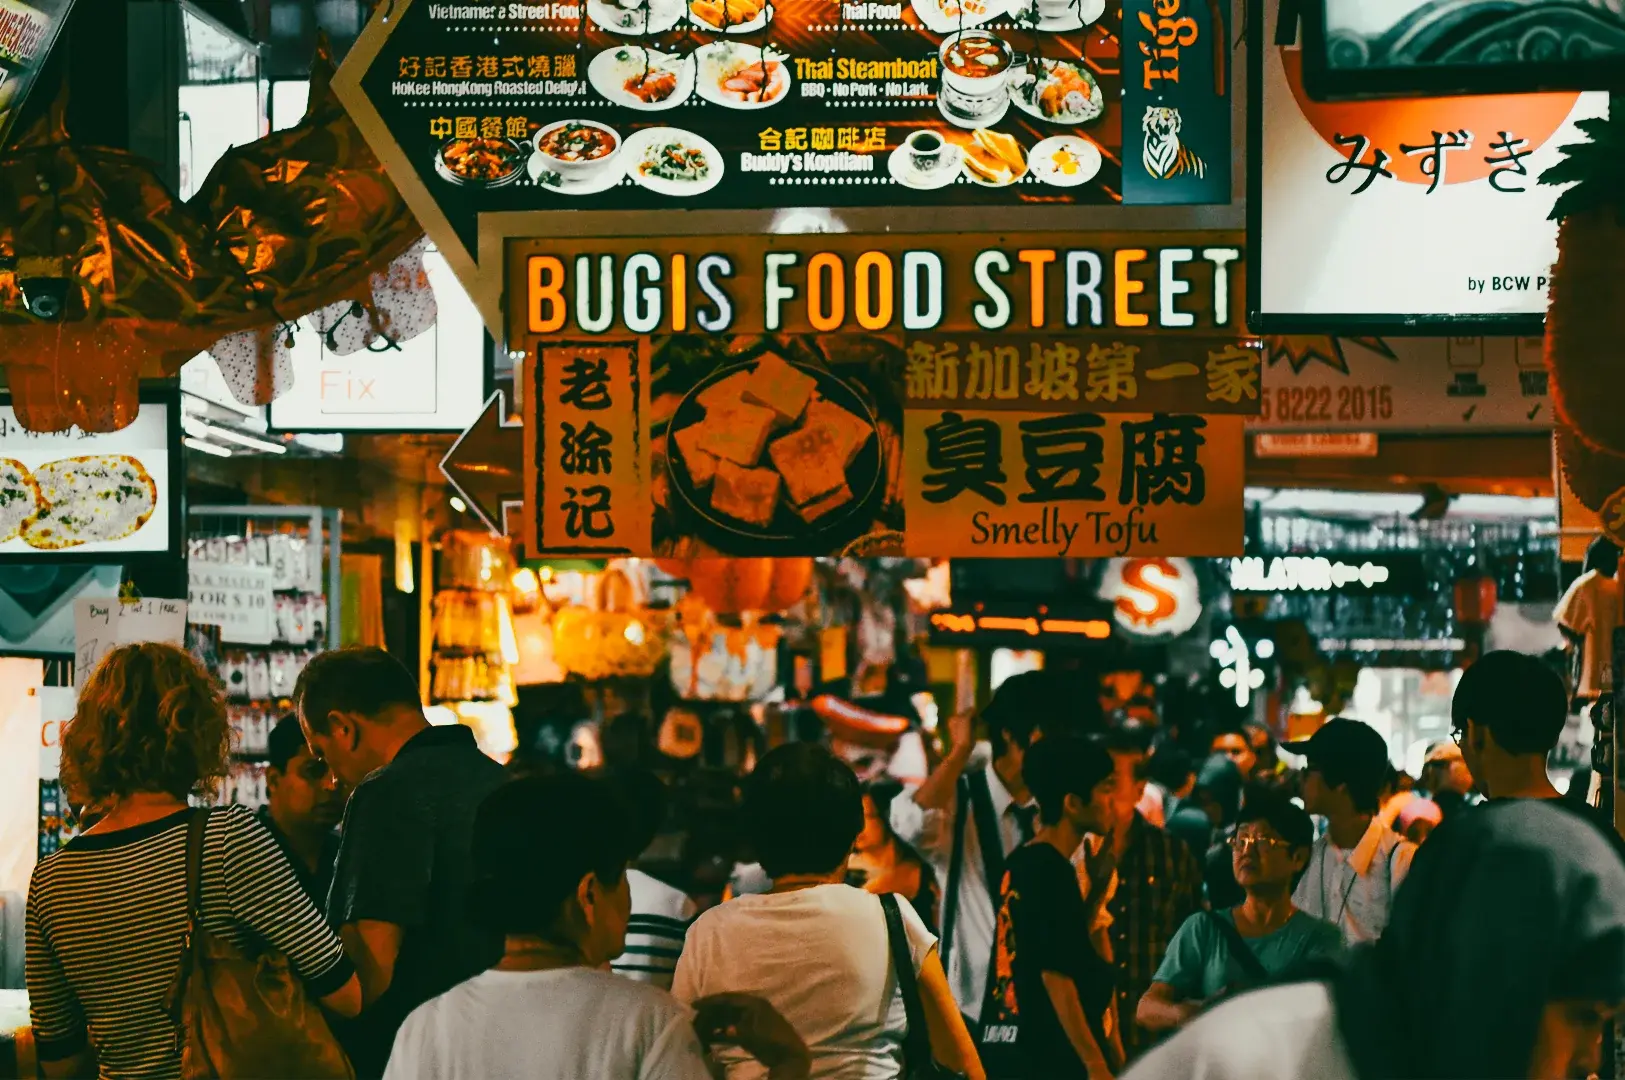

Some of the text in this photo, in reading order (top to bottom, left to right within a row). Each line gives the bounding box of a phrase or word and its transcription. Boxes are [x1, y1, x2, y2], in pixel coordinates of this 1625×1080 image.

[508, 3, 549, 19] Street
[868, 3, 902, 19] Food
[794, 57, 938, 79] Thai Steamboat
[392, 81, 430, 95] HoKee
[432, 81, 493, 97] HongKong
[494, 81, 543, 95] Roasted
[801, 83, 825, 98] BBQ
[833, 82, 850, 97] No
[850, 82, 877, 97] Pork
[885, 82, 903, 97] No
[430, 116, 527, 139] 中國餐館
[758, 127, 886, 150] 合記咖啡店
[741, 152, 873, 173] Buddy's Kopitiam
[1326, 129, 1534, 195] みずき
[528, 248, 1239, 333] BUGIS FOOD STREET
[1468, 276, 1485, 294] by
[1492, 276, 1530, 291] BCW
[905, 341, 1261, 403] 新加坡第一家
[320, 371, 375, 400] Fix
[1276, 386, 1332, 422] 8222
[1337, 385, 1393, 421] 2015
[921, 411, 1207, 505] 臭豆腐
[971, 506, 1159, 557] Smelly Tofu
[89, 604, 109, 625] Buy
